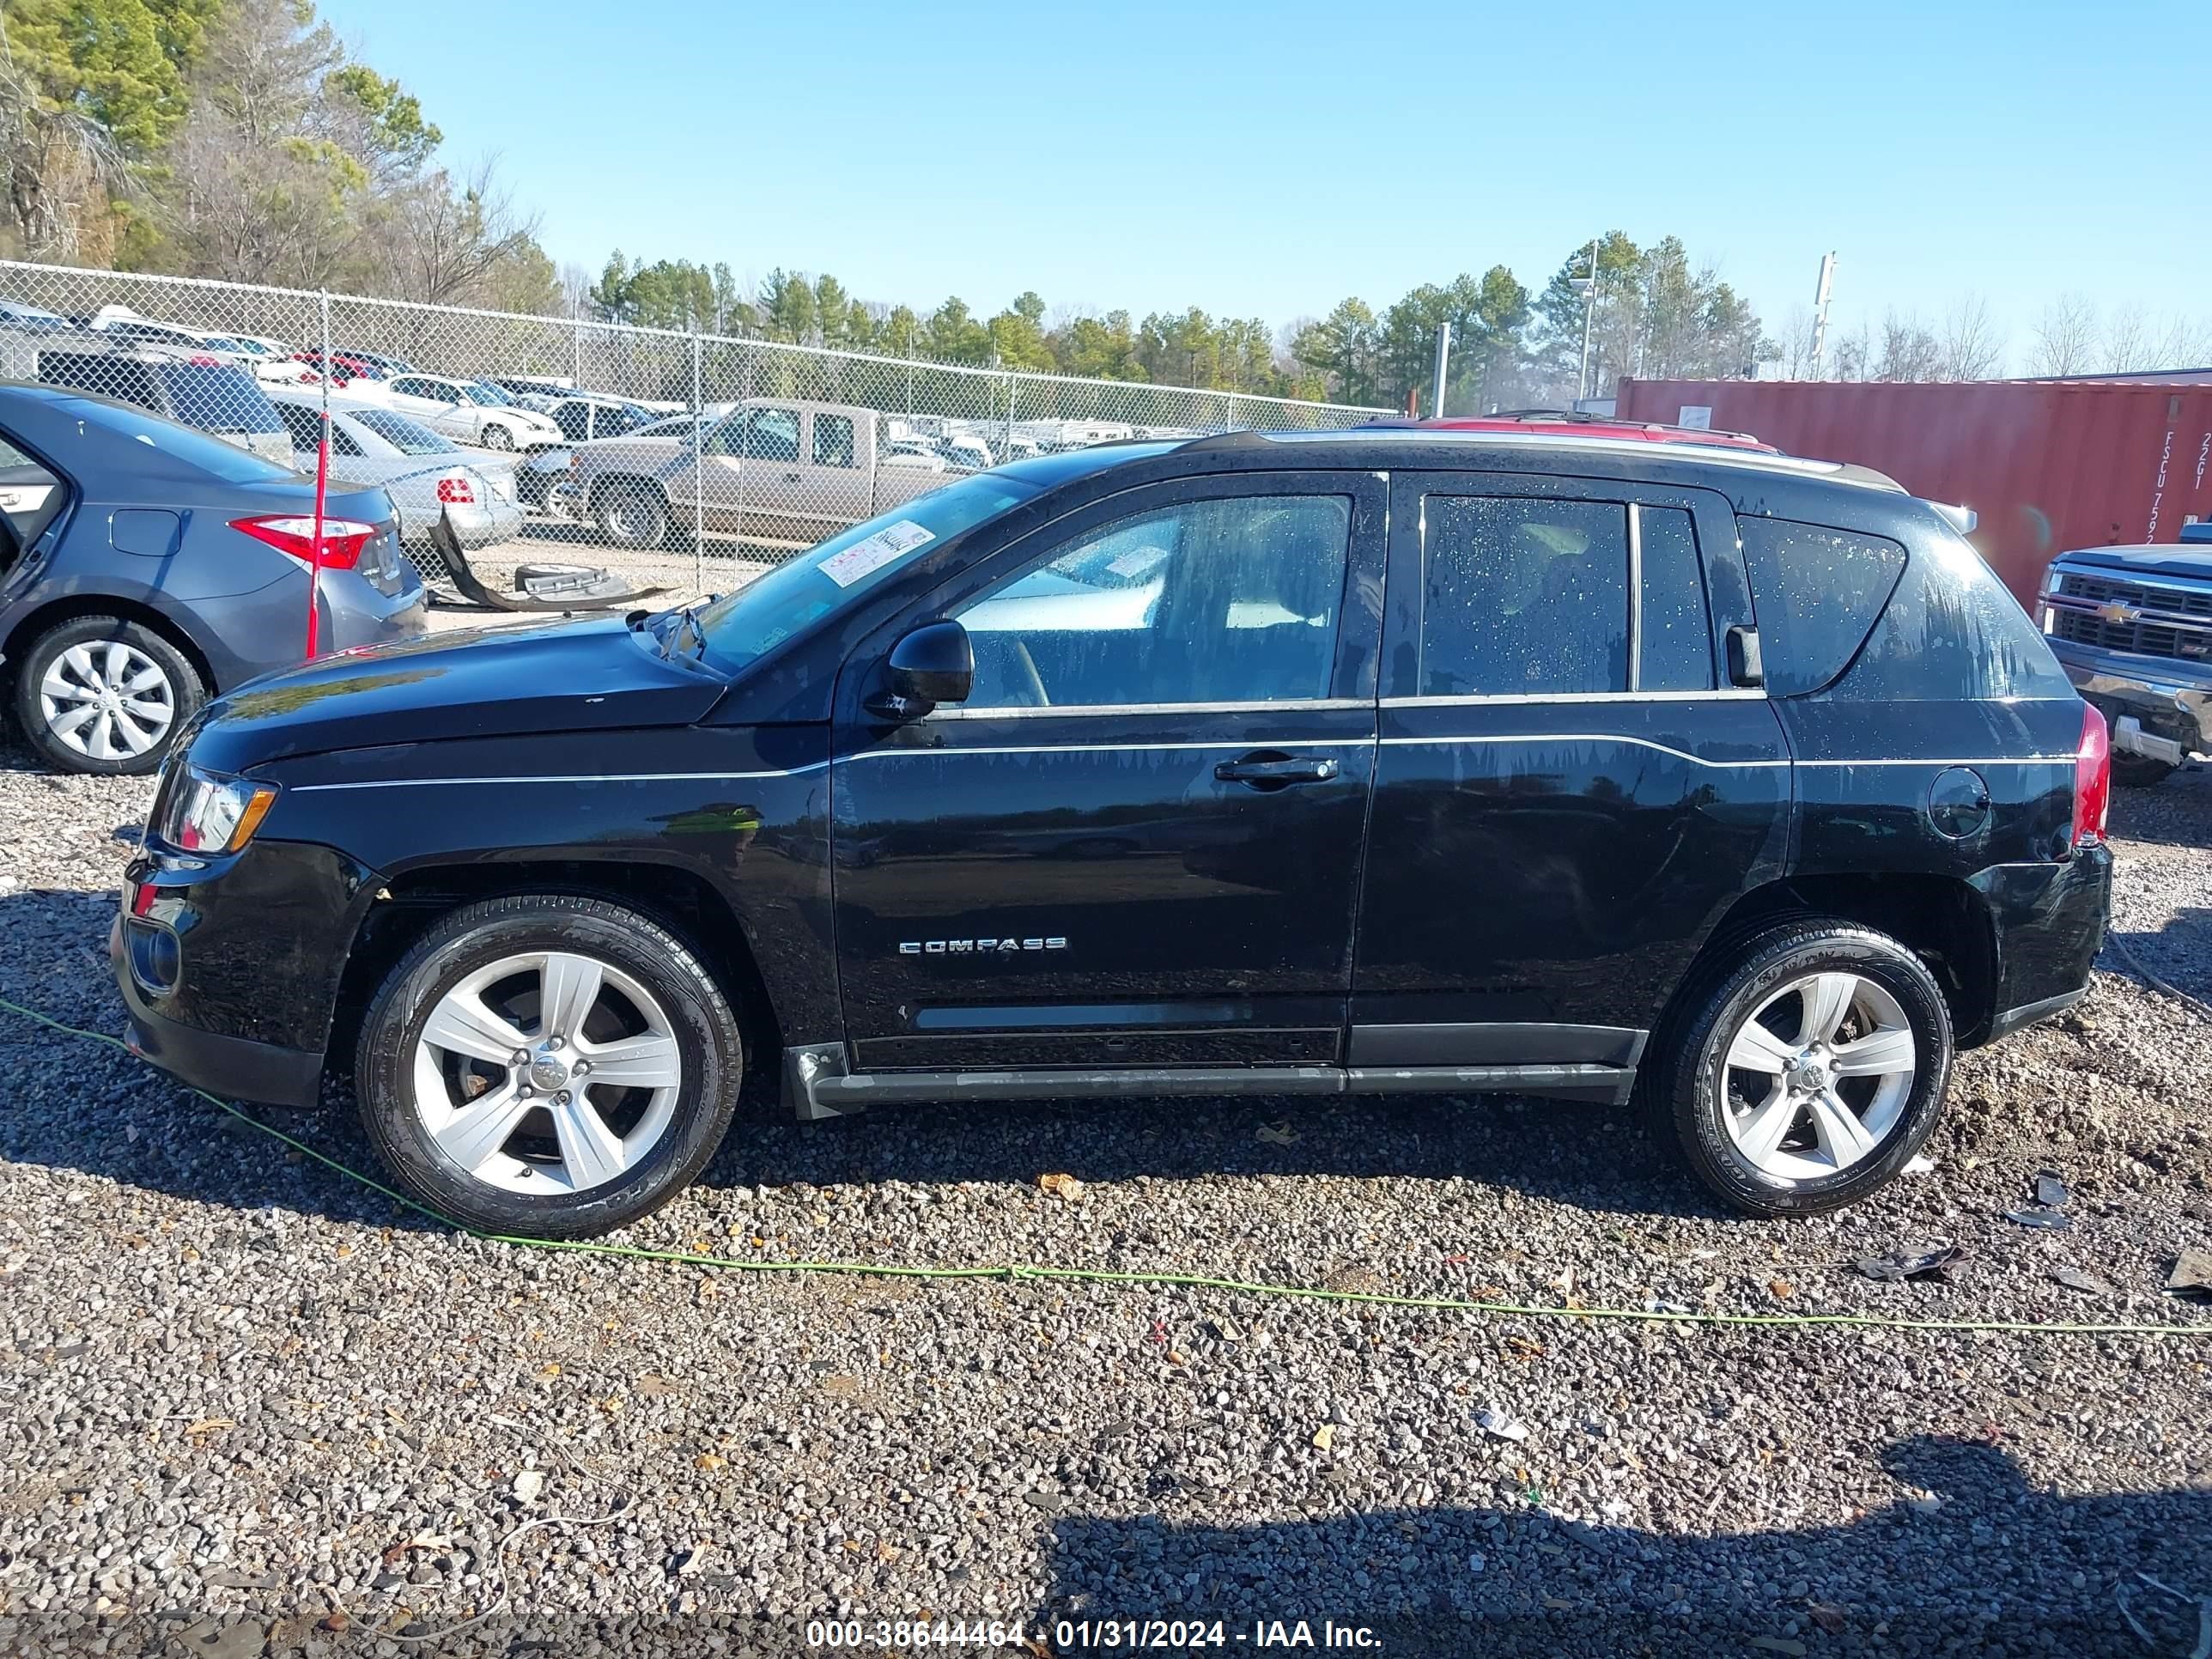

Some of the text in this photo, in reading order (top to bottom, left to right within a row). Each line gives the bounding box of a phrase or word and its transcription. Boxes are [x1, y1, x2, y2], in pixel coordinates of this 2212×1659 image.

[2157, 431, 2174, 489] FSCU
[2195, 432, 2212, 489] 22G1
[899, 937, 1066, 954] COMPASS
